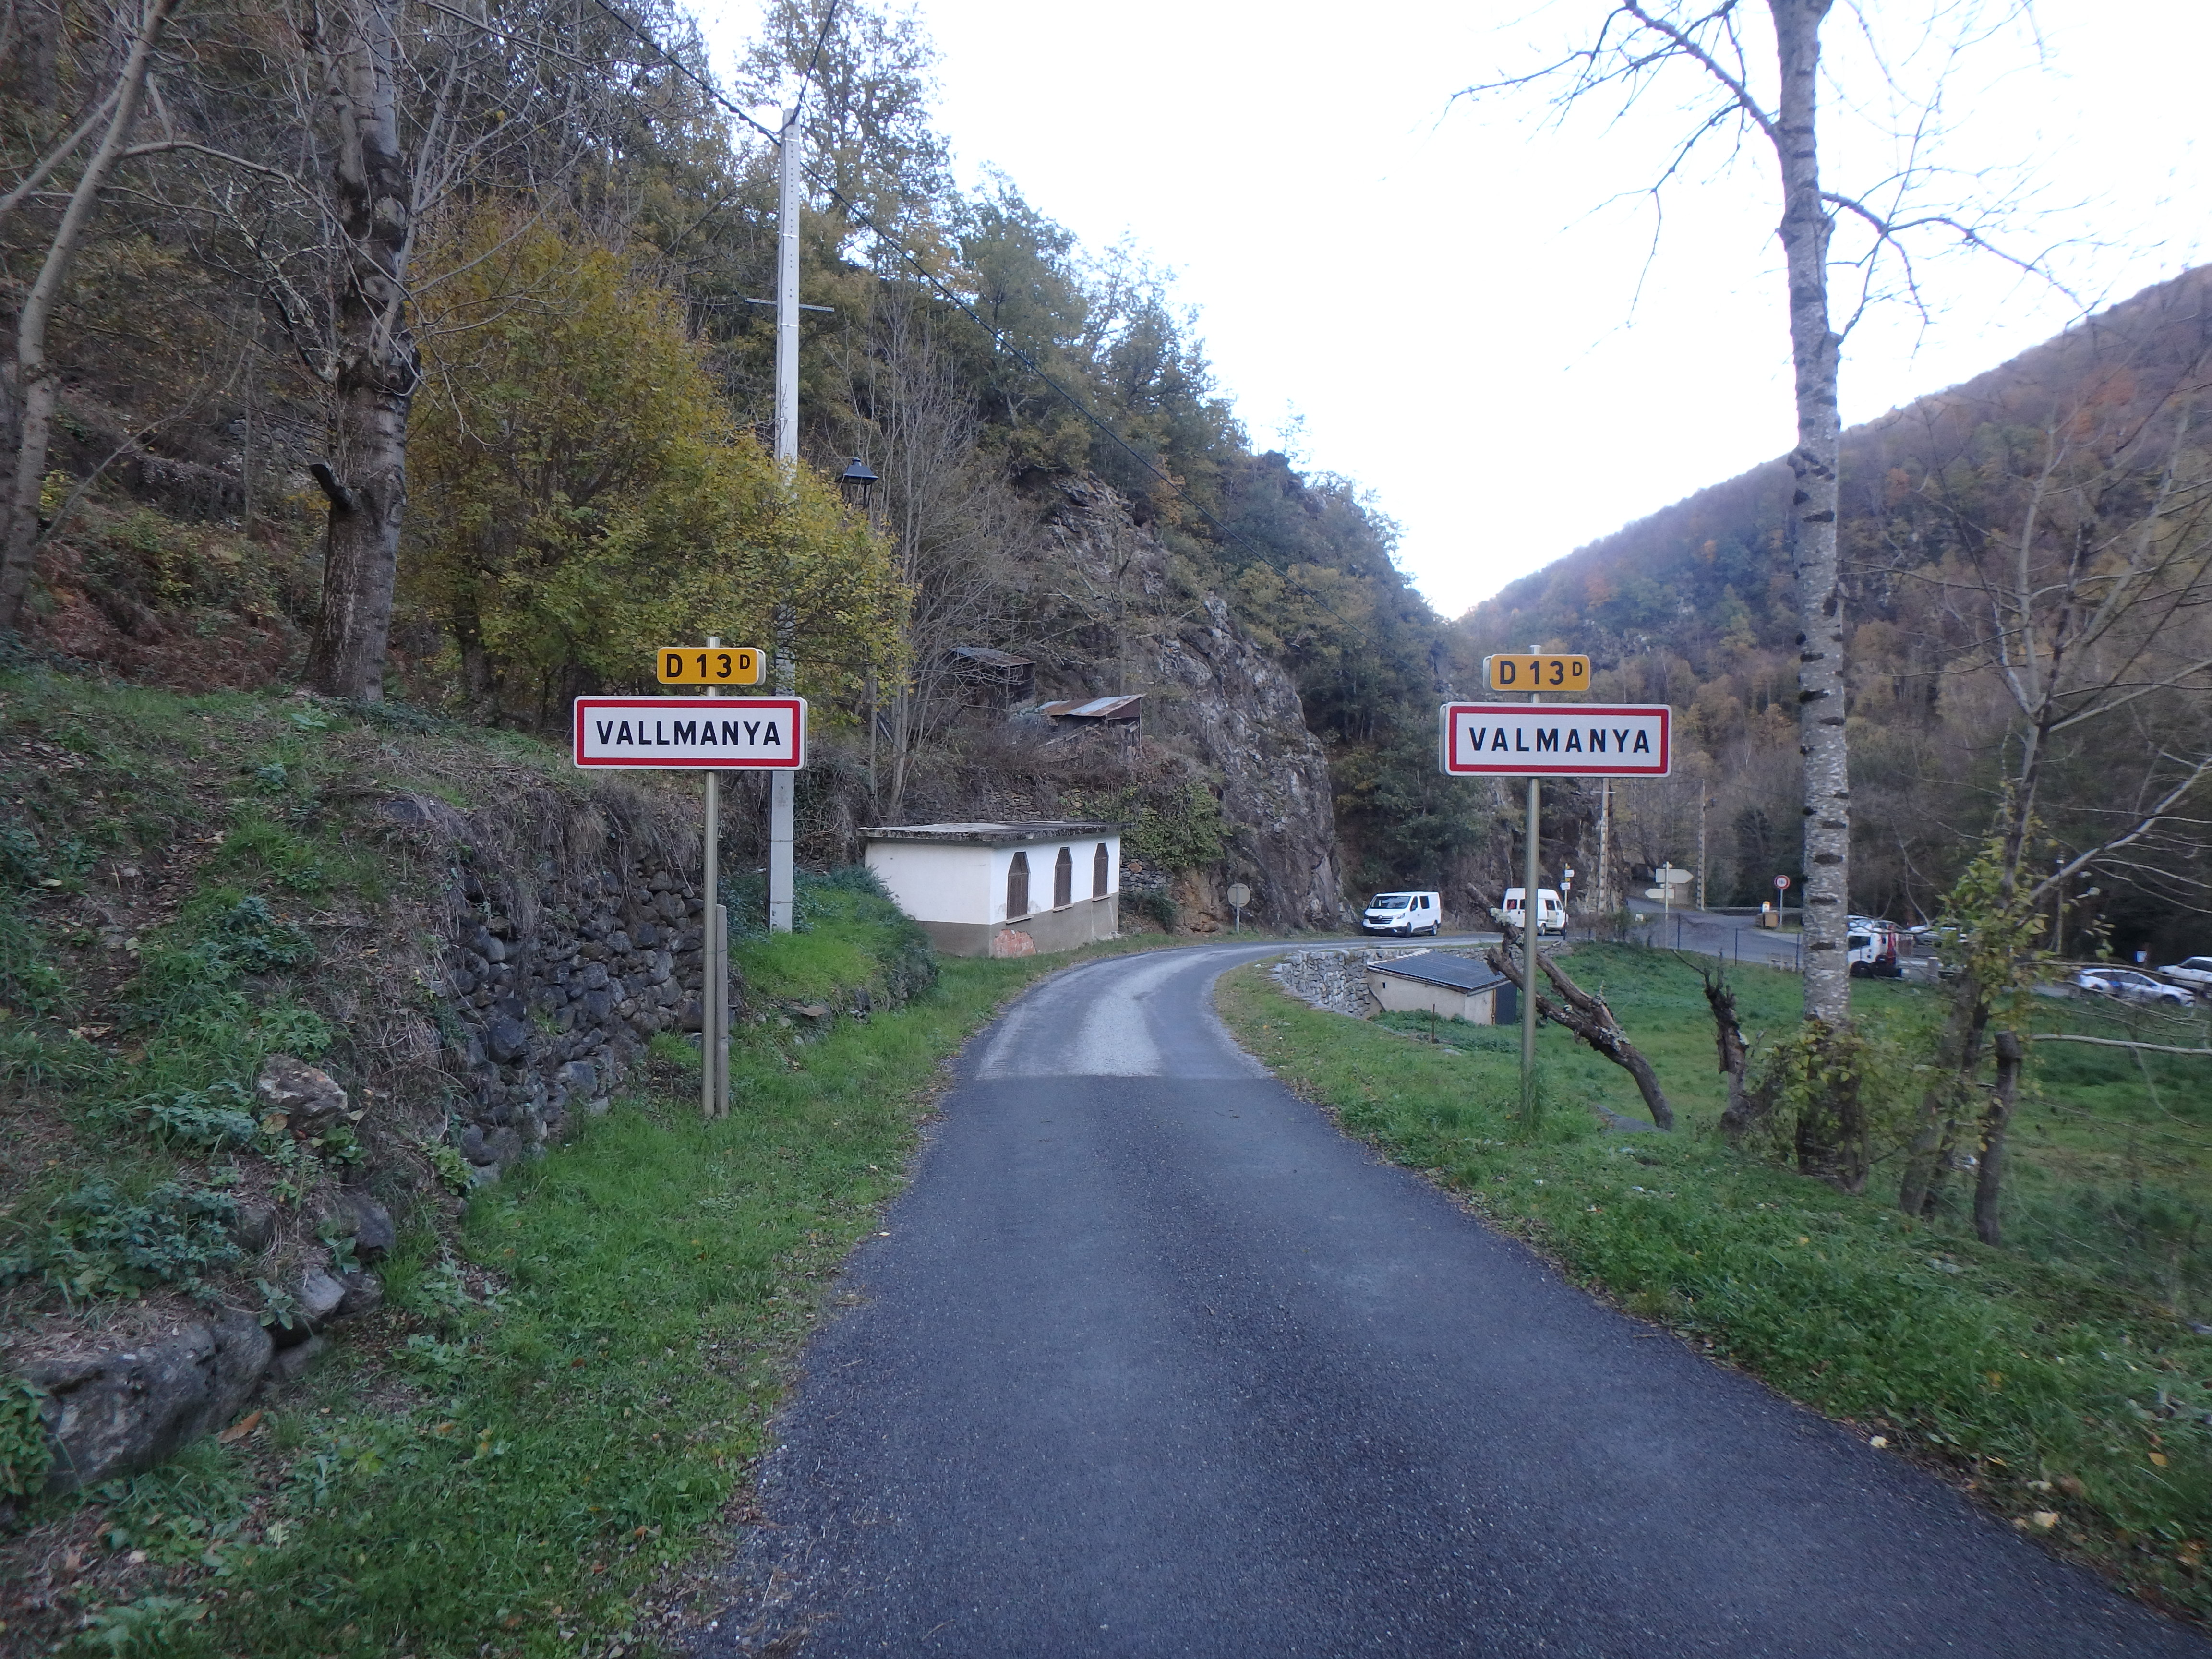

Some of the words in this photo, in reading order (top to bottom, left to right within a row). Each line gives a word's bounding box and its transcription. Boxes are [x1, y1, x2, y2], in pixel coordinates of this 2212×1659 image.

[666, 654, 683, 678] D
[1499, 660, 1515, 685] D
[596, 721, 781, 746] VALLMANYA
[1468, 727, 1650, 753] VALMANYA
